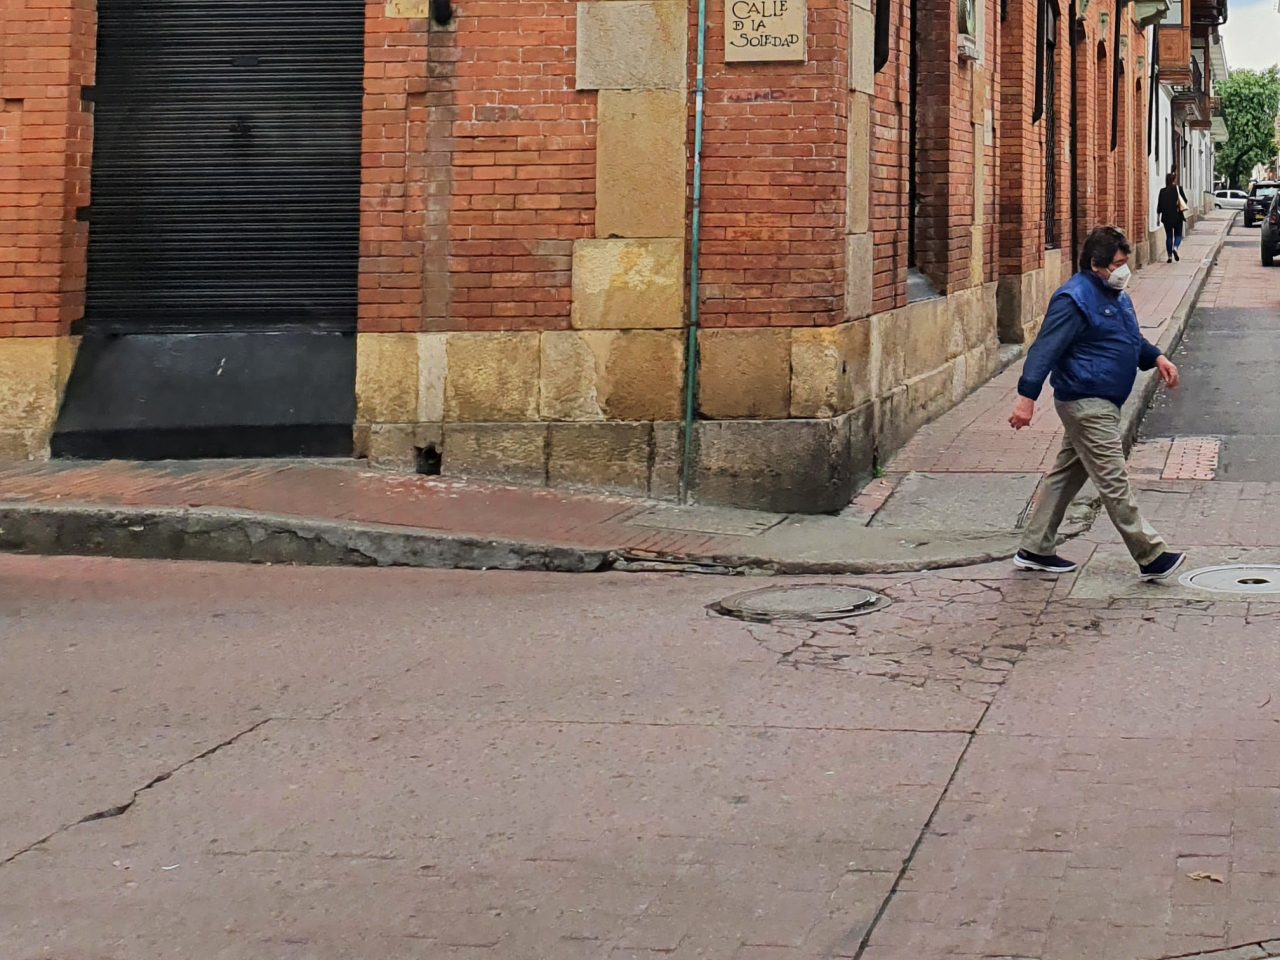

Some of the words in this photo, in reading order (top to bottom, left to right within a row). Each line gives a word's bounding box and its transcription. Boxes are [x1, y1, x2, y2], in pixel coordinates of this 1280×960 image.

[731, 0, 788, 20] CALLE
[750, 19, 767, 32] LA
[729, 33, 800, 48] SOLEDAD
